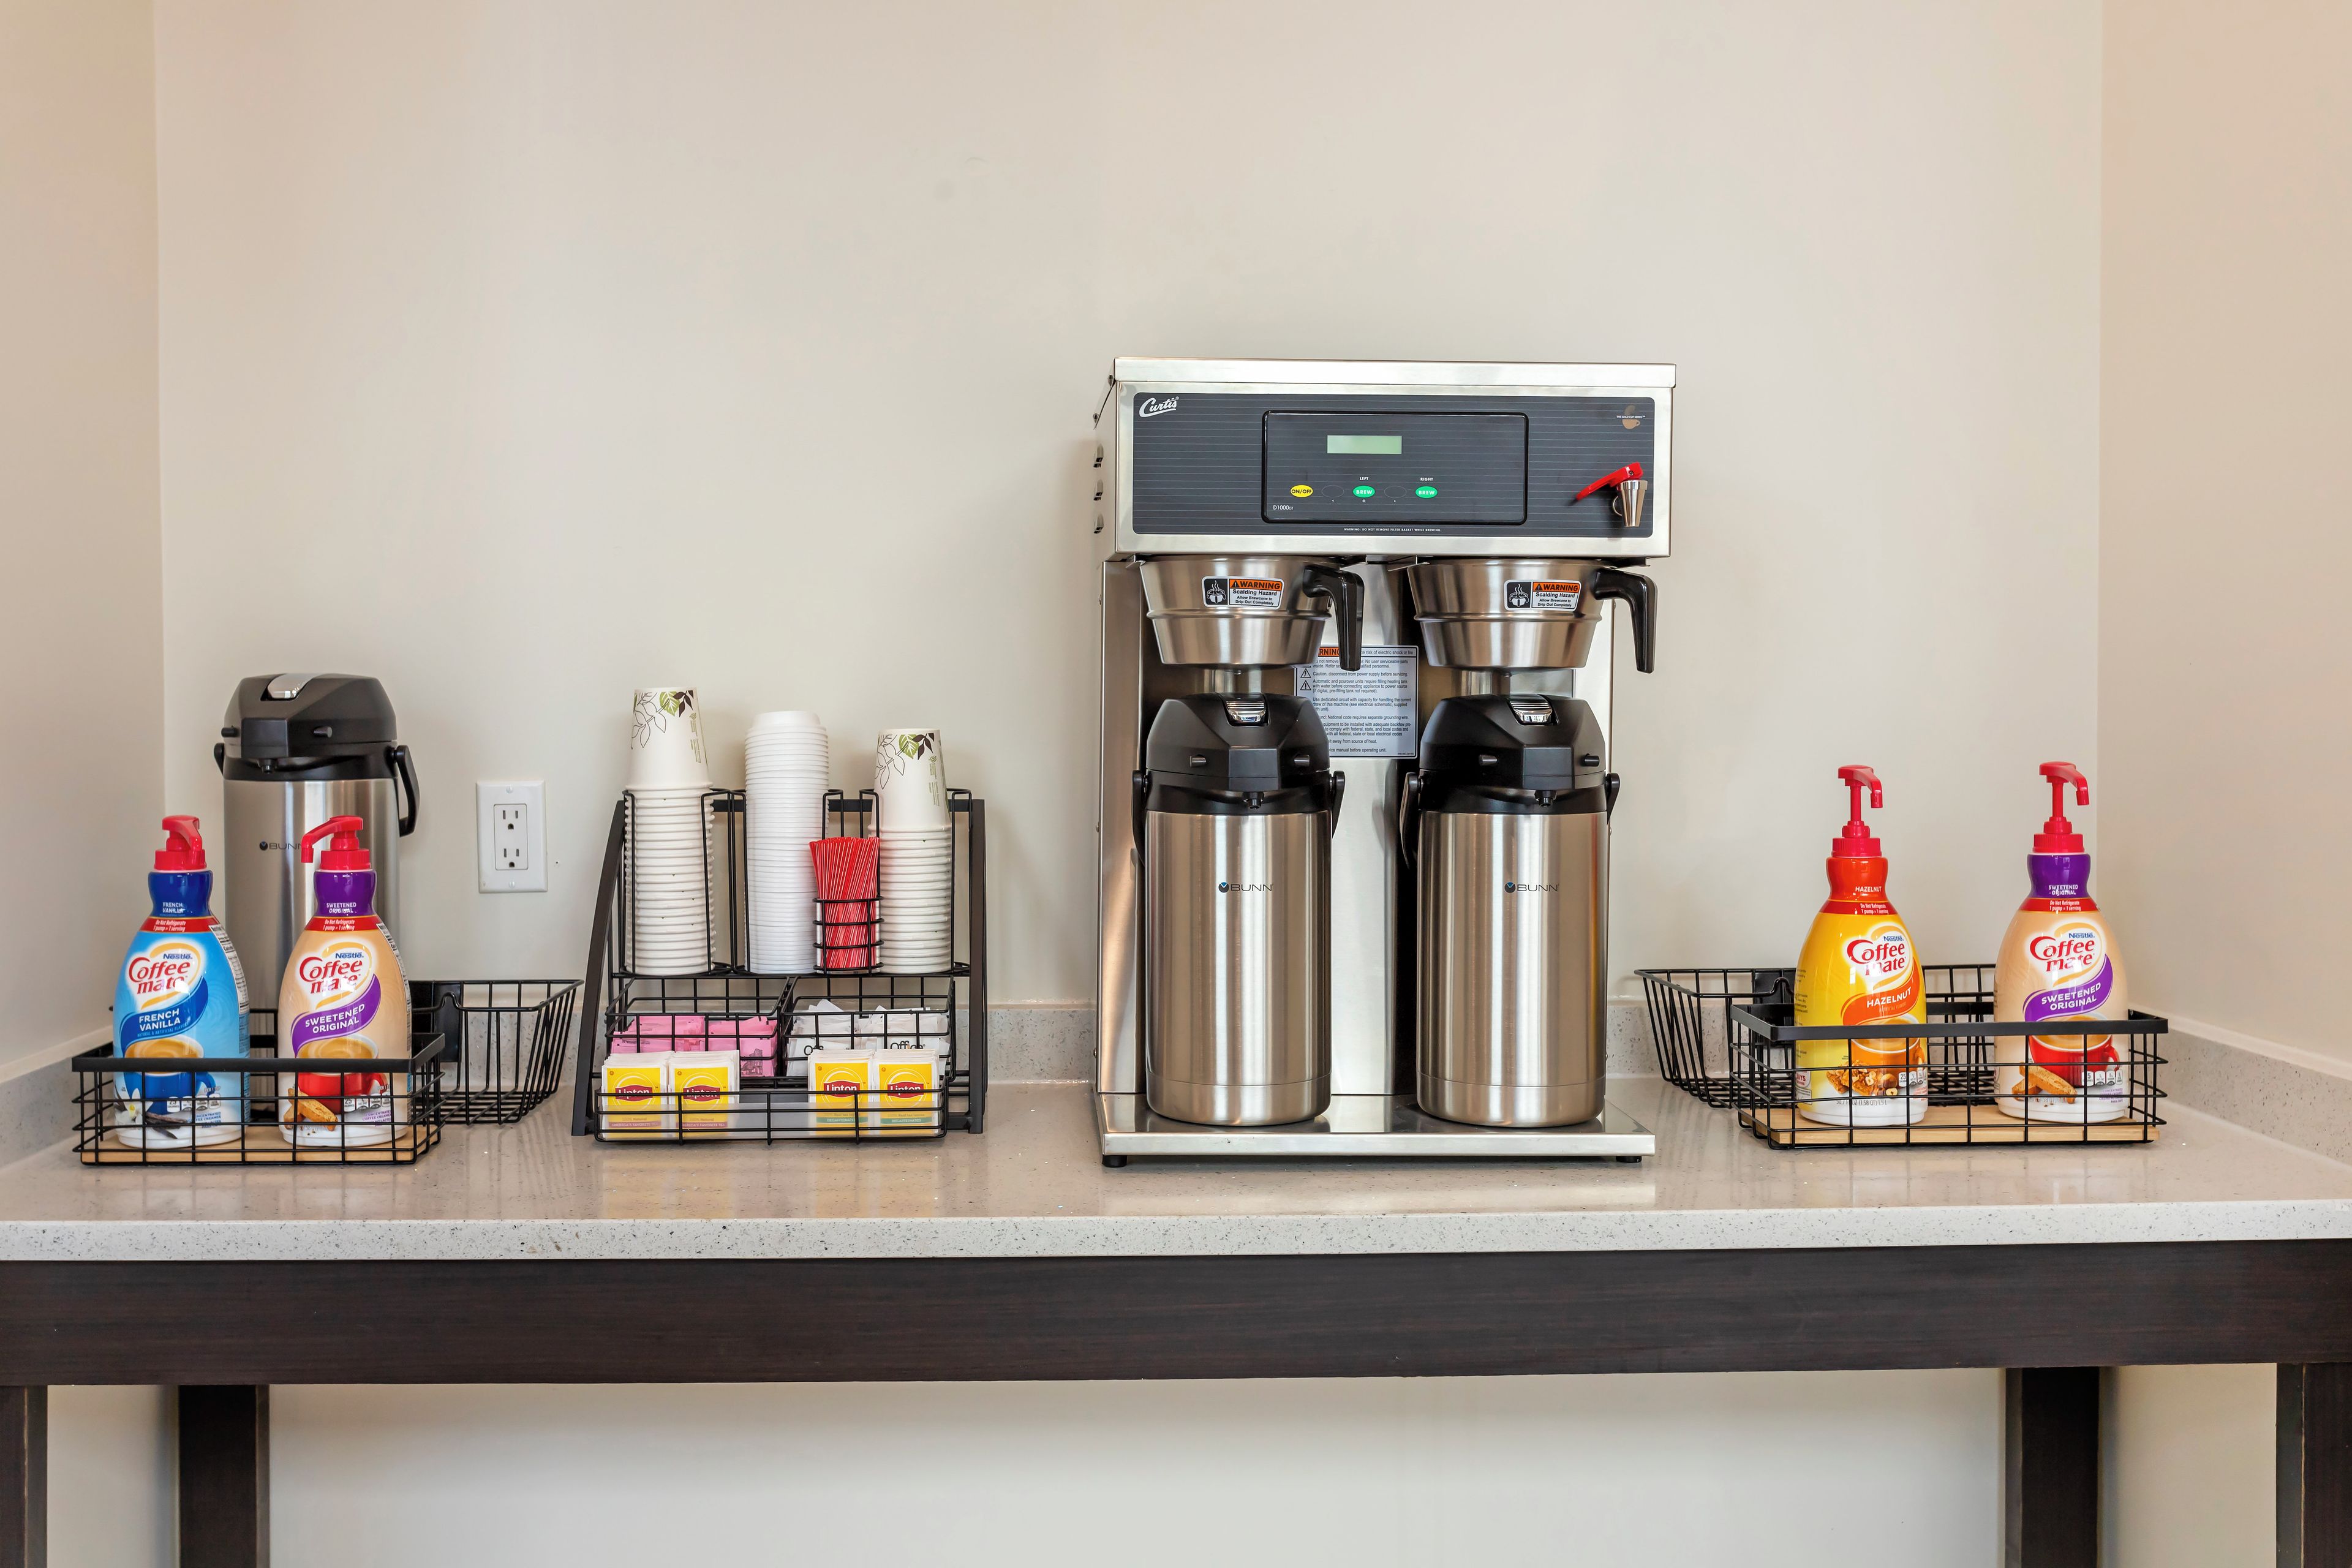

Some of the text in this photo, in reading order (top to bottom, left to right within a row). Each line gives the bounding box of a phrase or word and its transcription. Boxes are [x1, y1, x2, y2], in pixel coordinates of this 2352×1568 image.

[1139, 398, 1177, 417] Curtis
[1847, 939, 1905, 964] Coffee
[2030, 936, 2095, 961] Coffee
[129, 957, 190, 982] Coffee
[299, 957, 362, 982] Coffee
[1865, 957, 1905, 976] ate
[311, 975, 357, 994] mae
[2041, 982, 2101, 1004] SWEETENED
[1867, 986, 1911, 1008] HAZELNUT
[2050, 995, 2097, 1011] ORIGINAL
[139, 1008, 179, 1023] FRENCH
[140, 1017, 180, 1031] VANILLA
[305, 1004, 365, 1027] SWEETENED
[313, 1017, 359, 1033] ORIGINAL
[686, 1089, 717, 1099] Lipton
